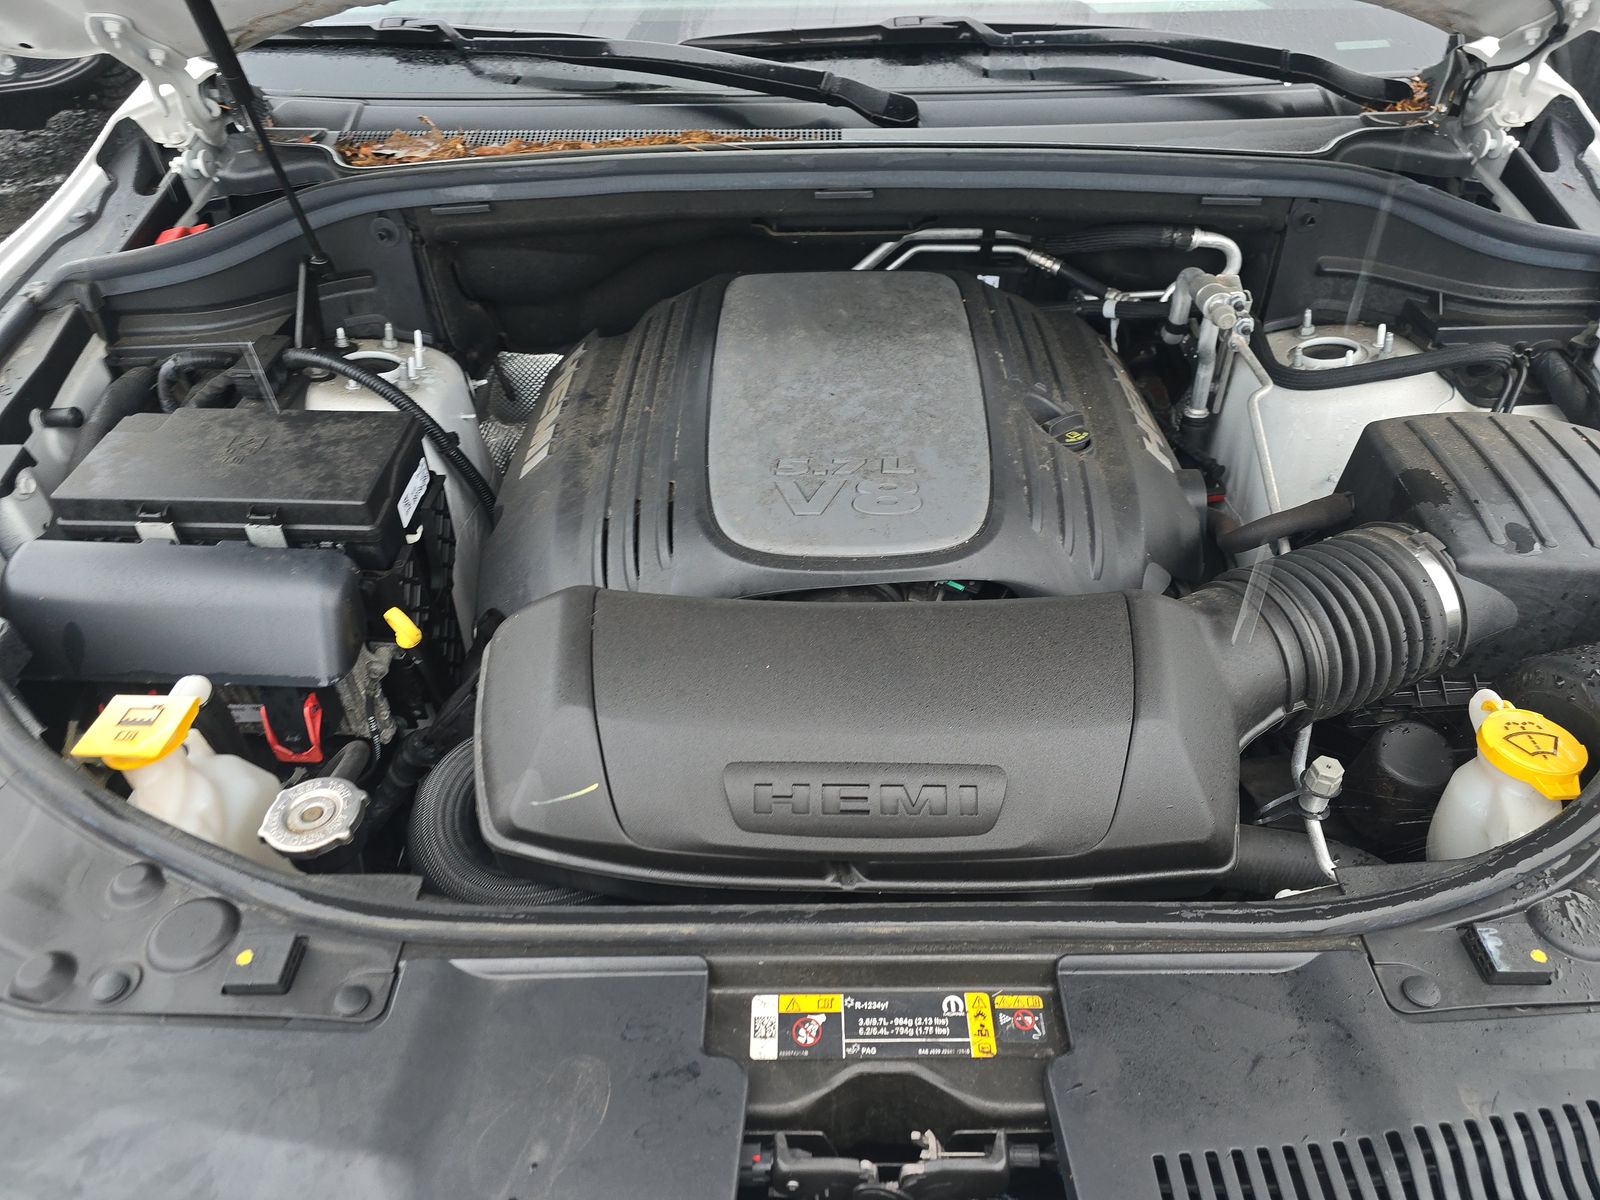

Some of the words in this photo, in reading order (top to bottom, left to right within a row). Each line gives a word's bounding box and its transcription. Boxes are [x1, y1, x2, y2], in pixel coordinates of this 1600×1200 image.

[773, 457, 917, 476] 5.7L
[774, 479, 923, 516] V8
[754, 783, 978, 816] HEMI
[854, 1001, 889, 1011] R-1234yf
[915, 1017, 933, 1027] (2.13
[934, 1017, 949, 1027] lbs)
[935, 1026, 950, 1036] lbs)
